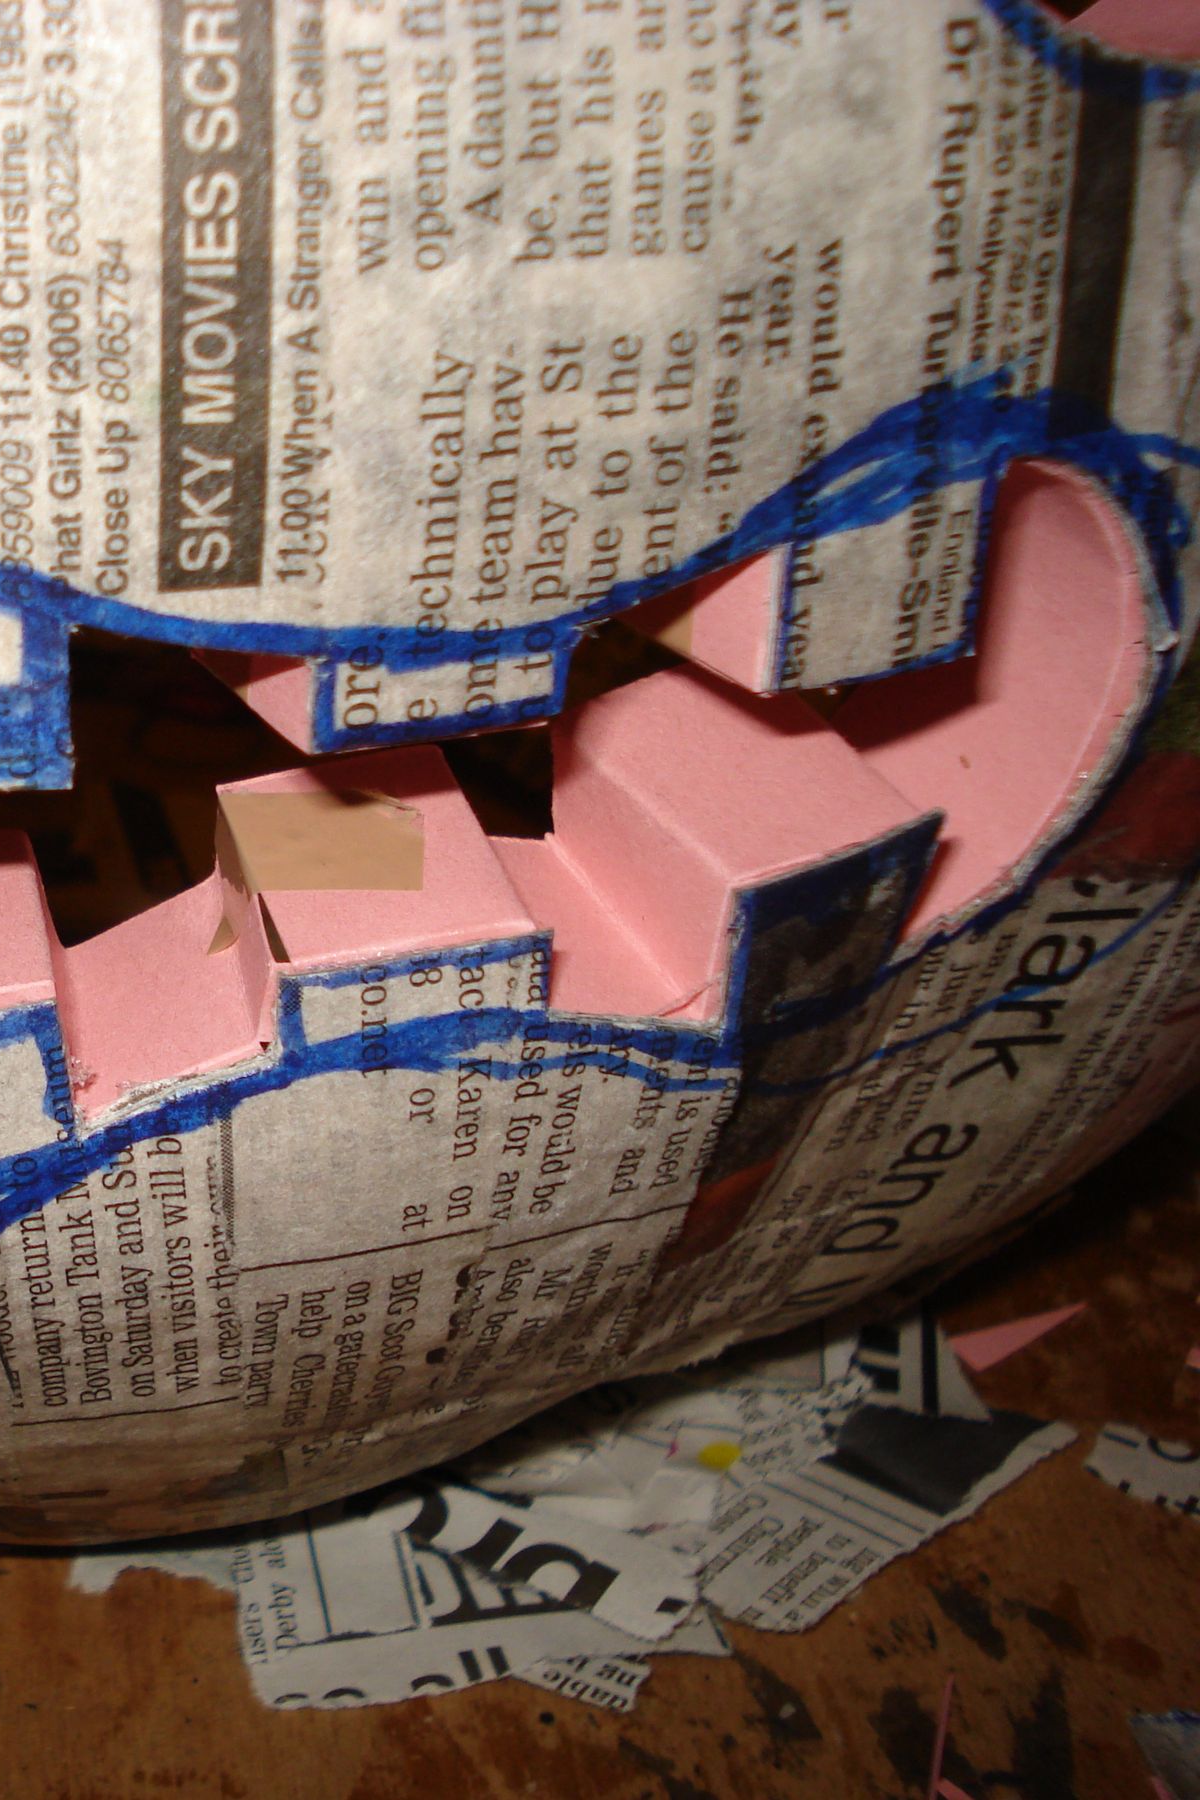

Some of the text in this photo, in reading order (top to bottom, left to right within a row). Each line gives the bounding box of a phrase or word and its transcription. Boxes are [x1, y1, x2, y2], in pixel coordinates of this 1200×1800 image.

[341, 45, 390, 276] win and
[404, 55, 458, 272] opening
[516, 78, 561, 162] but
[565, 44, 615, 261] that his
[678, 63, 718, 254] cause a
[929, 18, 981, 285] Dr Rupert
[462, 183, 505, 226] A
[628, 86, 668, 258] games
[286, 135, 332, 312] Stranger
[43, 273, 90, 396] (2006)
[179, 172, 239, 425] MOVIES
[286, 324, 321, 352] A
[807, 237, 846, 399] would
[476, 342, 526, 464] hav-
[537, 334, 587, 394] St
[593, 333, 645, 421] the
[651, 328, 699, 416] the
[702, 288, 757, 495] He said:
[47, 408, 83, 501] Girlz
[96, 419, 137, 475] Up
[279, 368, 320, 482] When
[535, 418, 580, 471] at
[645, 434, 690, 487] of
[177, 445, 237, 573] SKY
[408, 347, 477, 658] technically
[589, 448, 633, 501] to
[96, 487, 132, 596] Close
[276, 488, 313, 584] 11.00
[467, 473, 521, 606] team
[521, 496, 580, 605] play
[510, 624, 555, 673] to
[360, 965, 392, 1079] co.net
[511, 1022, 549, 1103] used
[451, 1057, 493, 1162] Karen
[501, 1113, 543, 1158] for
[539, 1083, 584, 1177] would
[649, 1095, 710, 1191] is used
[147, 1167, 191, 1229] will
[400, 1087, 439, 1233] or at
[446, 1185, 475, 1223] on
[529, 1179, 568, 1216] be
[608, 1148, 648, 1197] and
[819, 1123, 980, 1256] and
[46, 1043, 115, 1405] Bovington Tank Museum
[6, 1155, 73, 1408] company returns to
[104, 1196, 157, 1398] on Saturday and
[162, 1234, 198, 1336] visitors
[249, 1294, 290, 1357] Town
[341, 1281, 372, 1327] on a
[380, 1268, 425, 1363] BIG Scot
[495, 1257, 534, 1303] also
[532, 1265, 574, 1301] Mr
[171, 1340, 201, 1395] when
[213, 1364, 243, 1387] to
[280, 1287, 337, 1428] help Cherries
[266, 1583, 299, 1651] Derby
